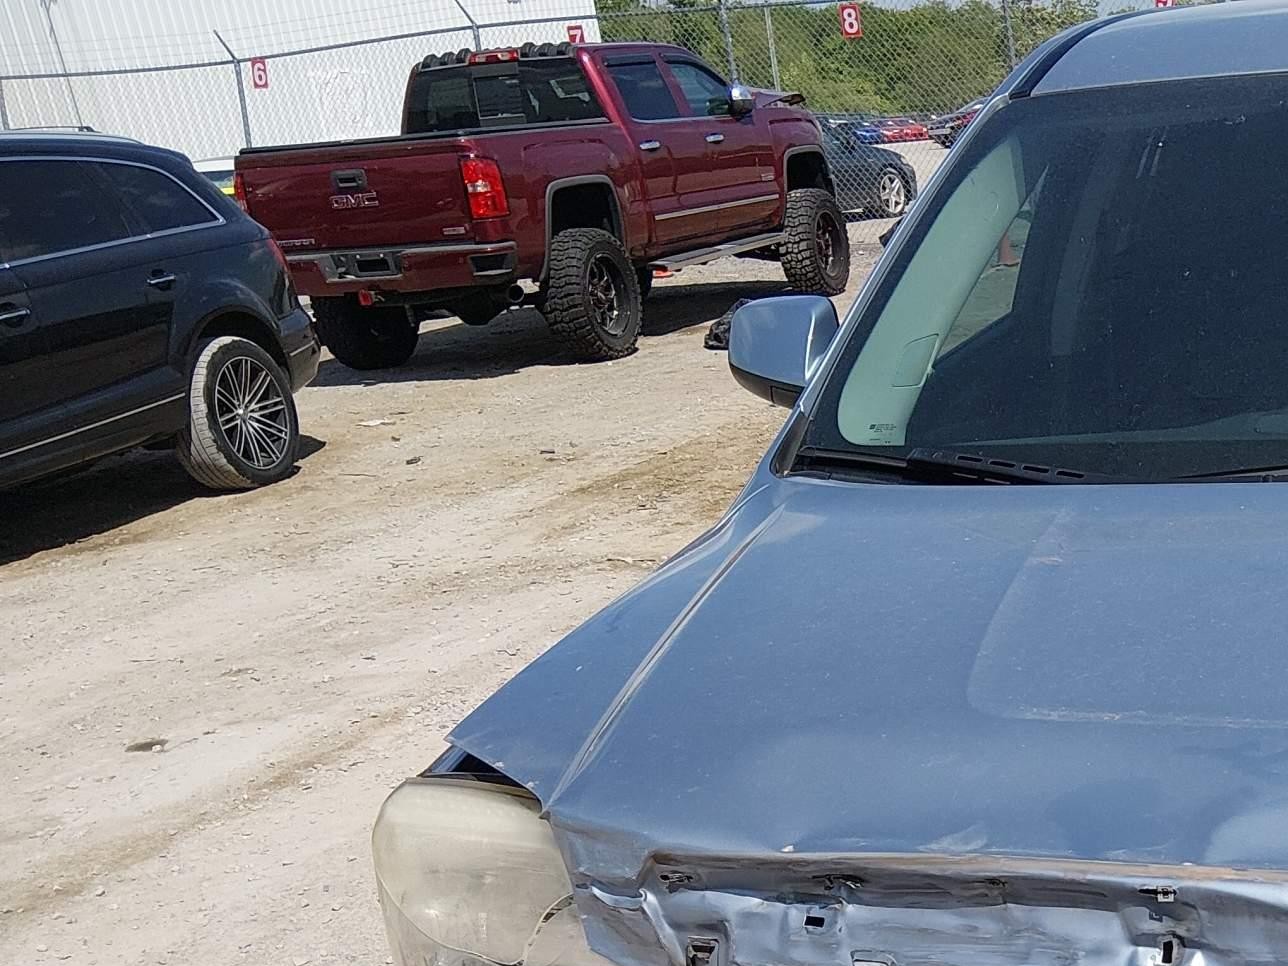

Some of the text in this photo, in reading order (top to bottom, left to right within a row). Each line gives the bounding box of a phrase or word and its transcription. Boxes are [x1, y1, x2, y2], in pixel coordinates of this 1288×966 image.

[843, 8, 858, 34] 8
[253, 62, 267, 86] 6
[330, 191, 380, 209] GMC
